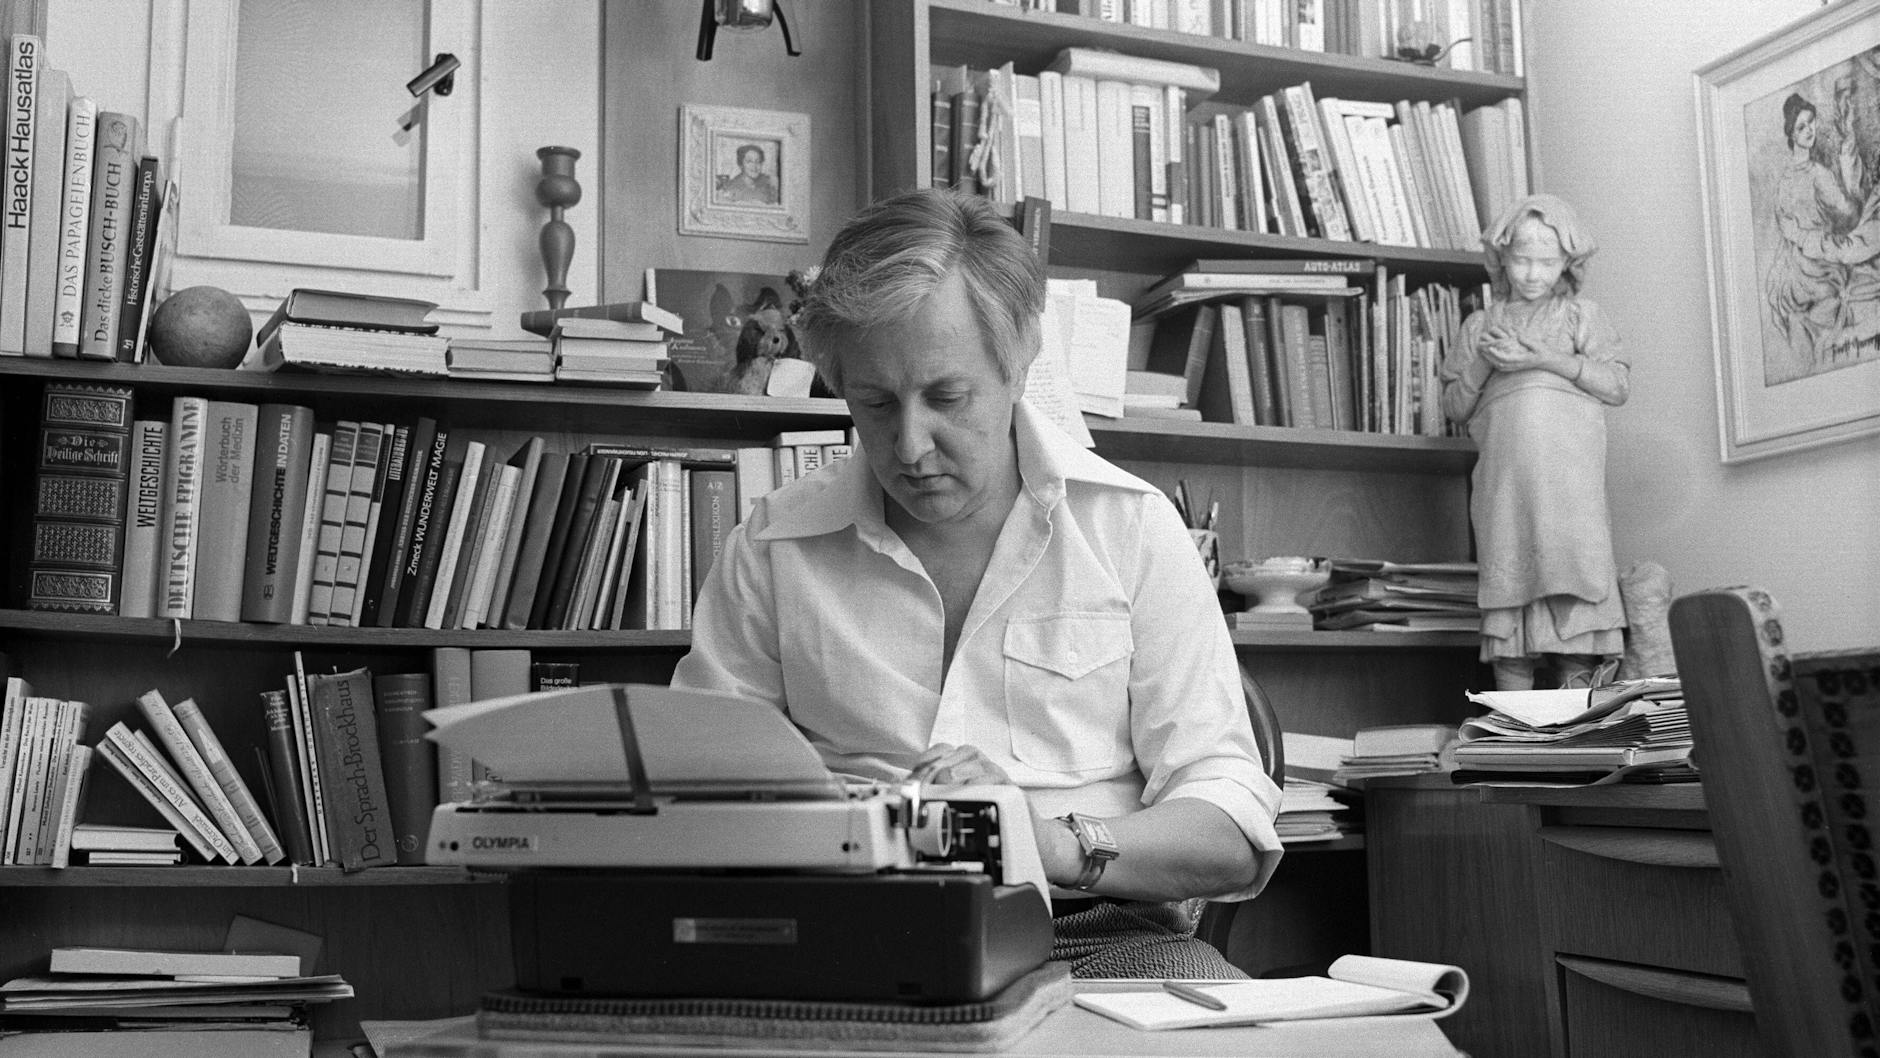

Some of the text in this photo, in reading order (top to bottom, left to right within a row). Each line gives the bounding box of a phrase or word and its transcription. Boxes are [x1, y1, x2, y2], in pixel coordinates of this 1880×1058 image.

[8, 41, 34, 231] Haack Hausatlas
[63, 113, 92, 298] DAS PAPAGEIENBUCH
[94, 162, 122, 343] Das dicke BUSCH-BUCH
[127, 258, 142, 306] Historische
[139, 170, 154, 201] Europa
[1303, 261, 1360, 272] AUTO-ATLAS
[71, 434, 96, 447] Die
[84, 448, 119, 466] Schrift
[215, 416, 233, 483] Wörterbuch
[228, 418, 244, 484] der Medizin
[431, 432, 447, 468] MAGIE
[136, 426, 163, 528] WELTGESCHICHTE
[266, 413, 293, 576] WELTGESCHICHTE IN DATEN
[167, 401, 200, 611] DEUTSCHE EPIGRAMME
[414, 467, 438, 542] WUNDERWELT
[407, 543, 423, 577] Zmeck
[112, 727, 138, 755] regnete
[131, 751, 161, 782] Paradies
[157, 776, 170, 789] im
[166, 785, 177, 796] es
[337, 680, 382, 863] Der Sprach-Brockhaus
[171, 793, 187, 810] Als
[472, 836, 529, 850] OLYMPIA
